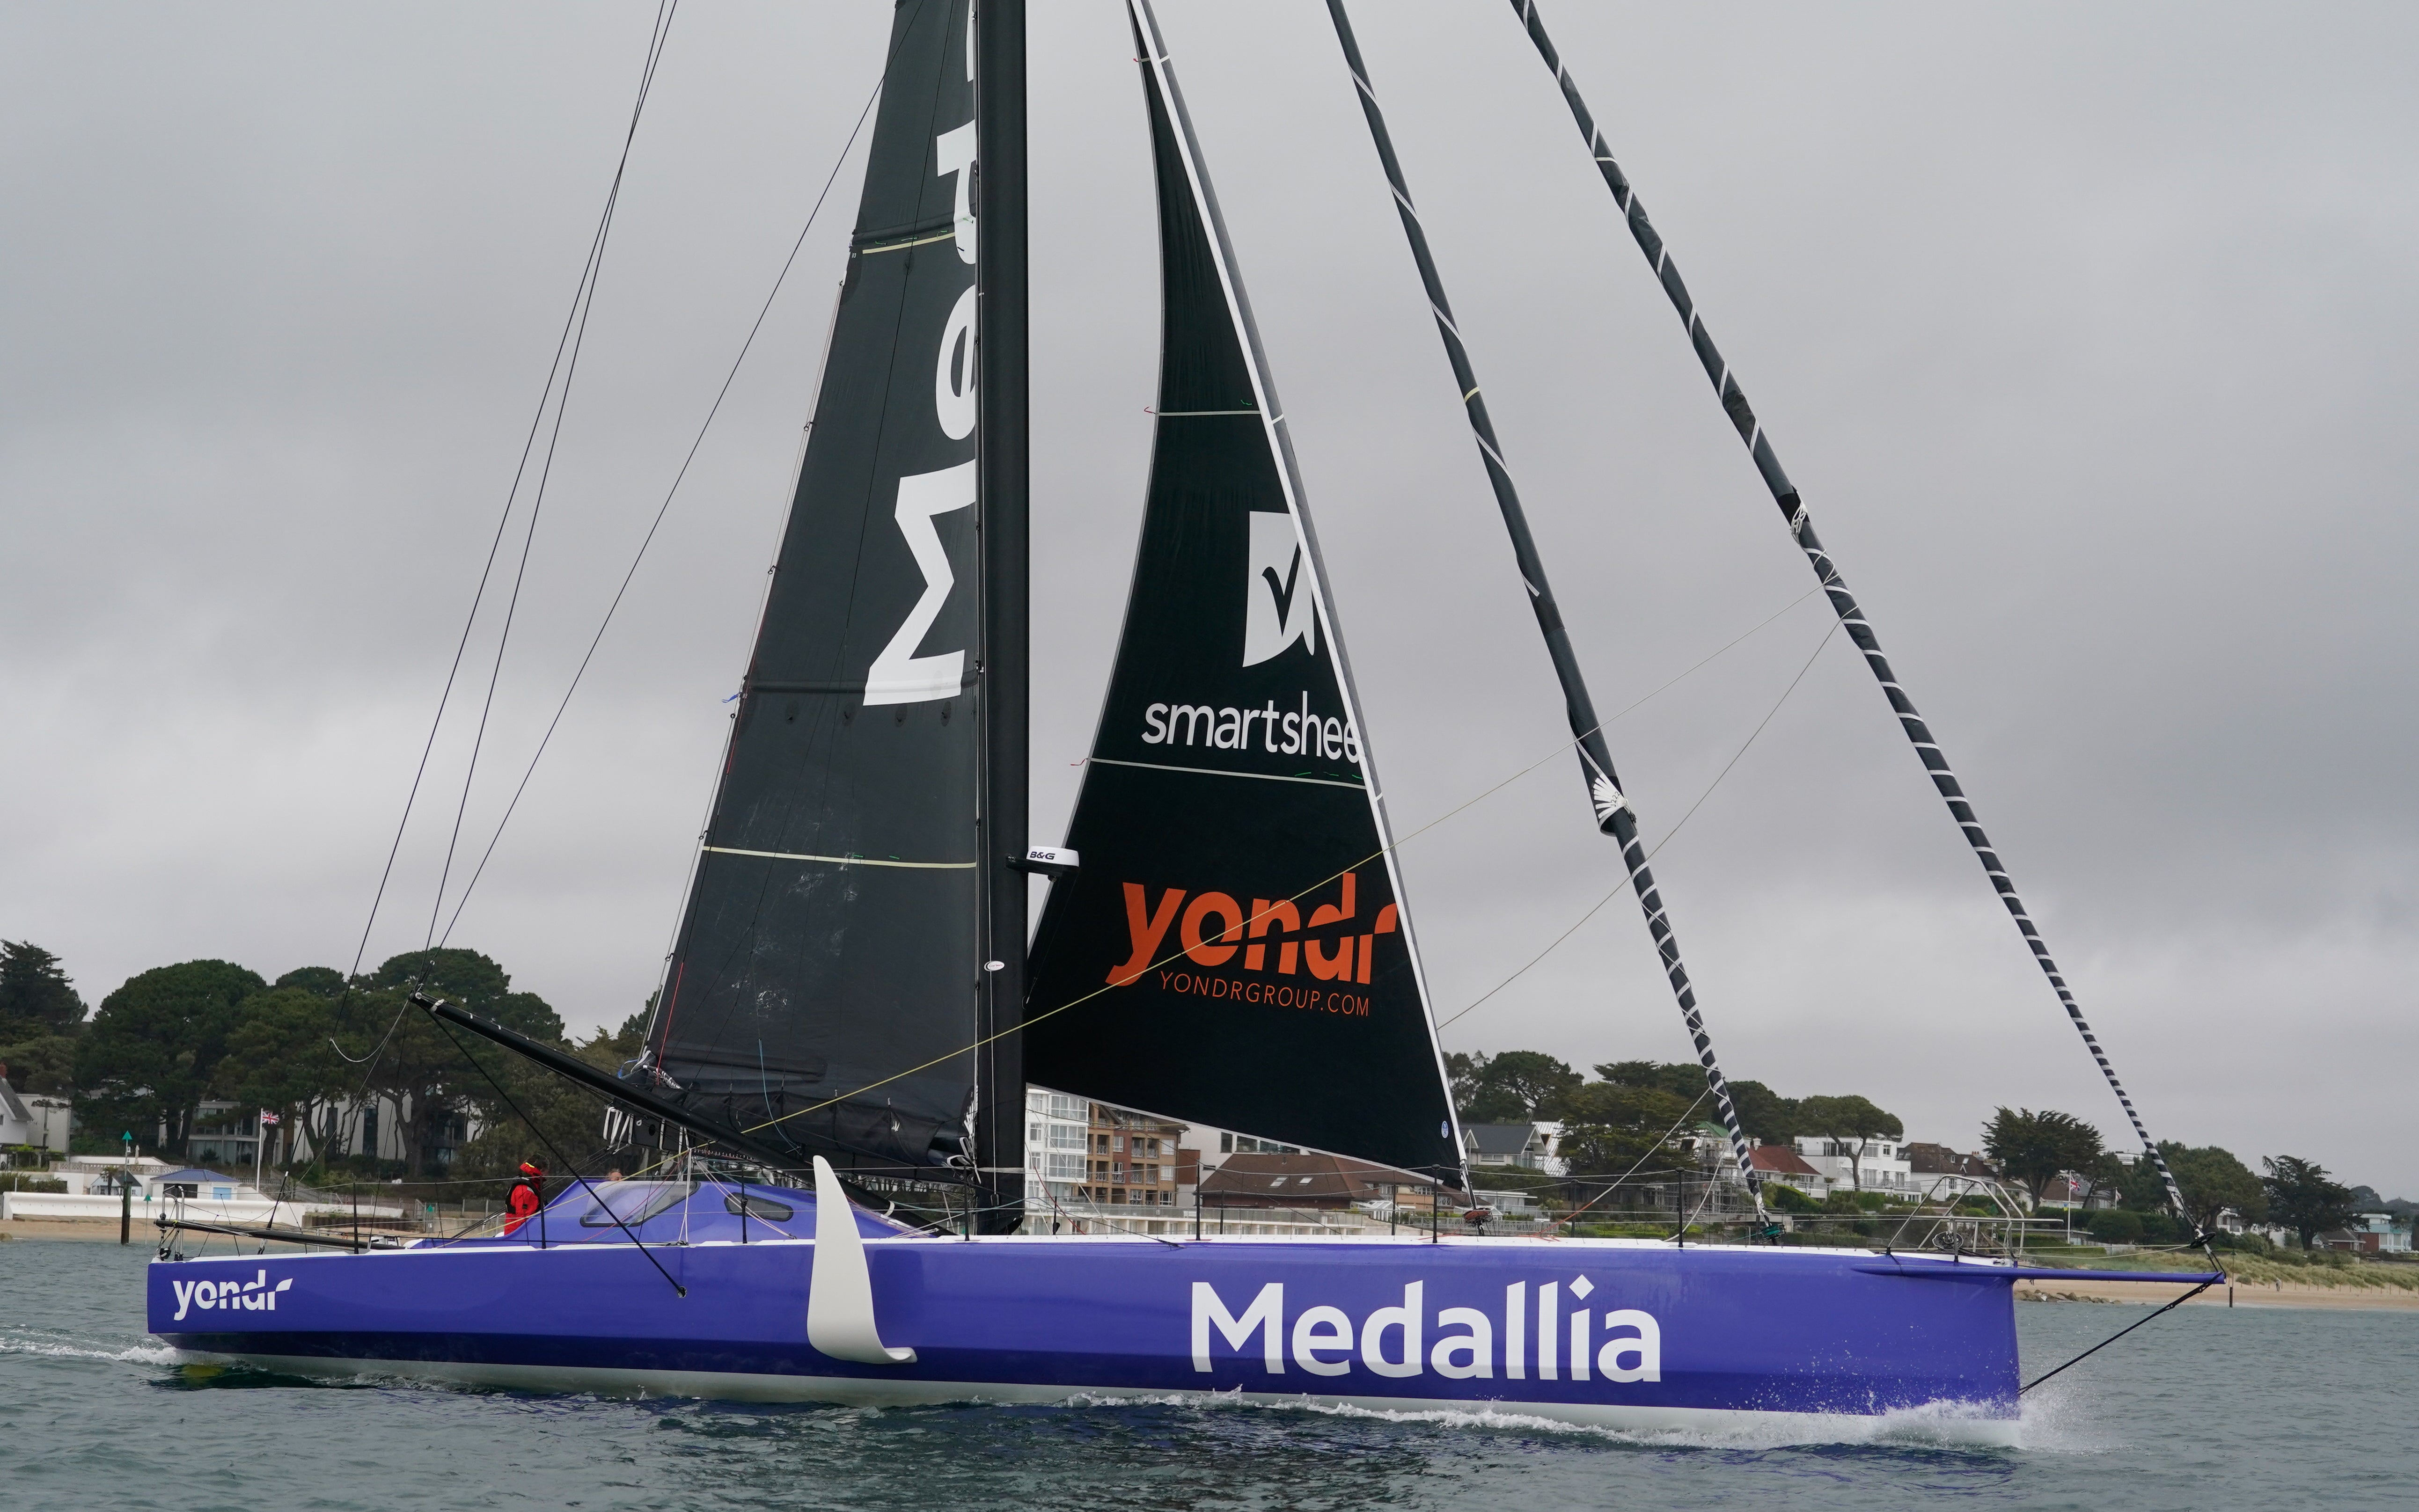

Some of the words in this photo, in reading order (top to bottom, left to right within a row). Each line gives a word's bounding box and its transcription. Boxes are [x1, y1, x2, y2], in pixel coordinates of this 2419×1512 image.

[1030, 851, 1056, 860] B&G
[1105, 872, 1398, 986] yondr
[1160, 970, 1370, 1017] YONDRGROUP.COM
[172, 1269, 293, 1321] yondr
[1191, 1274, 1661, 1383] Medallia
